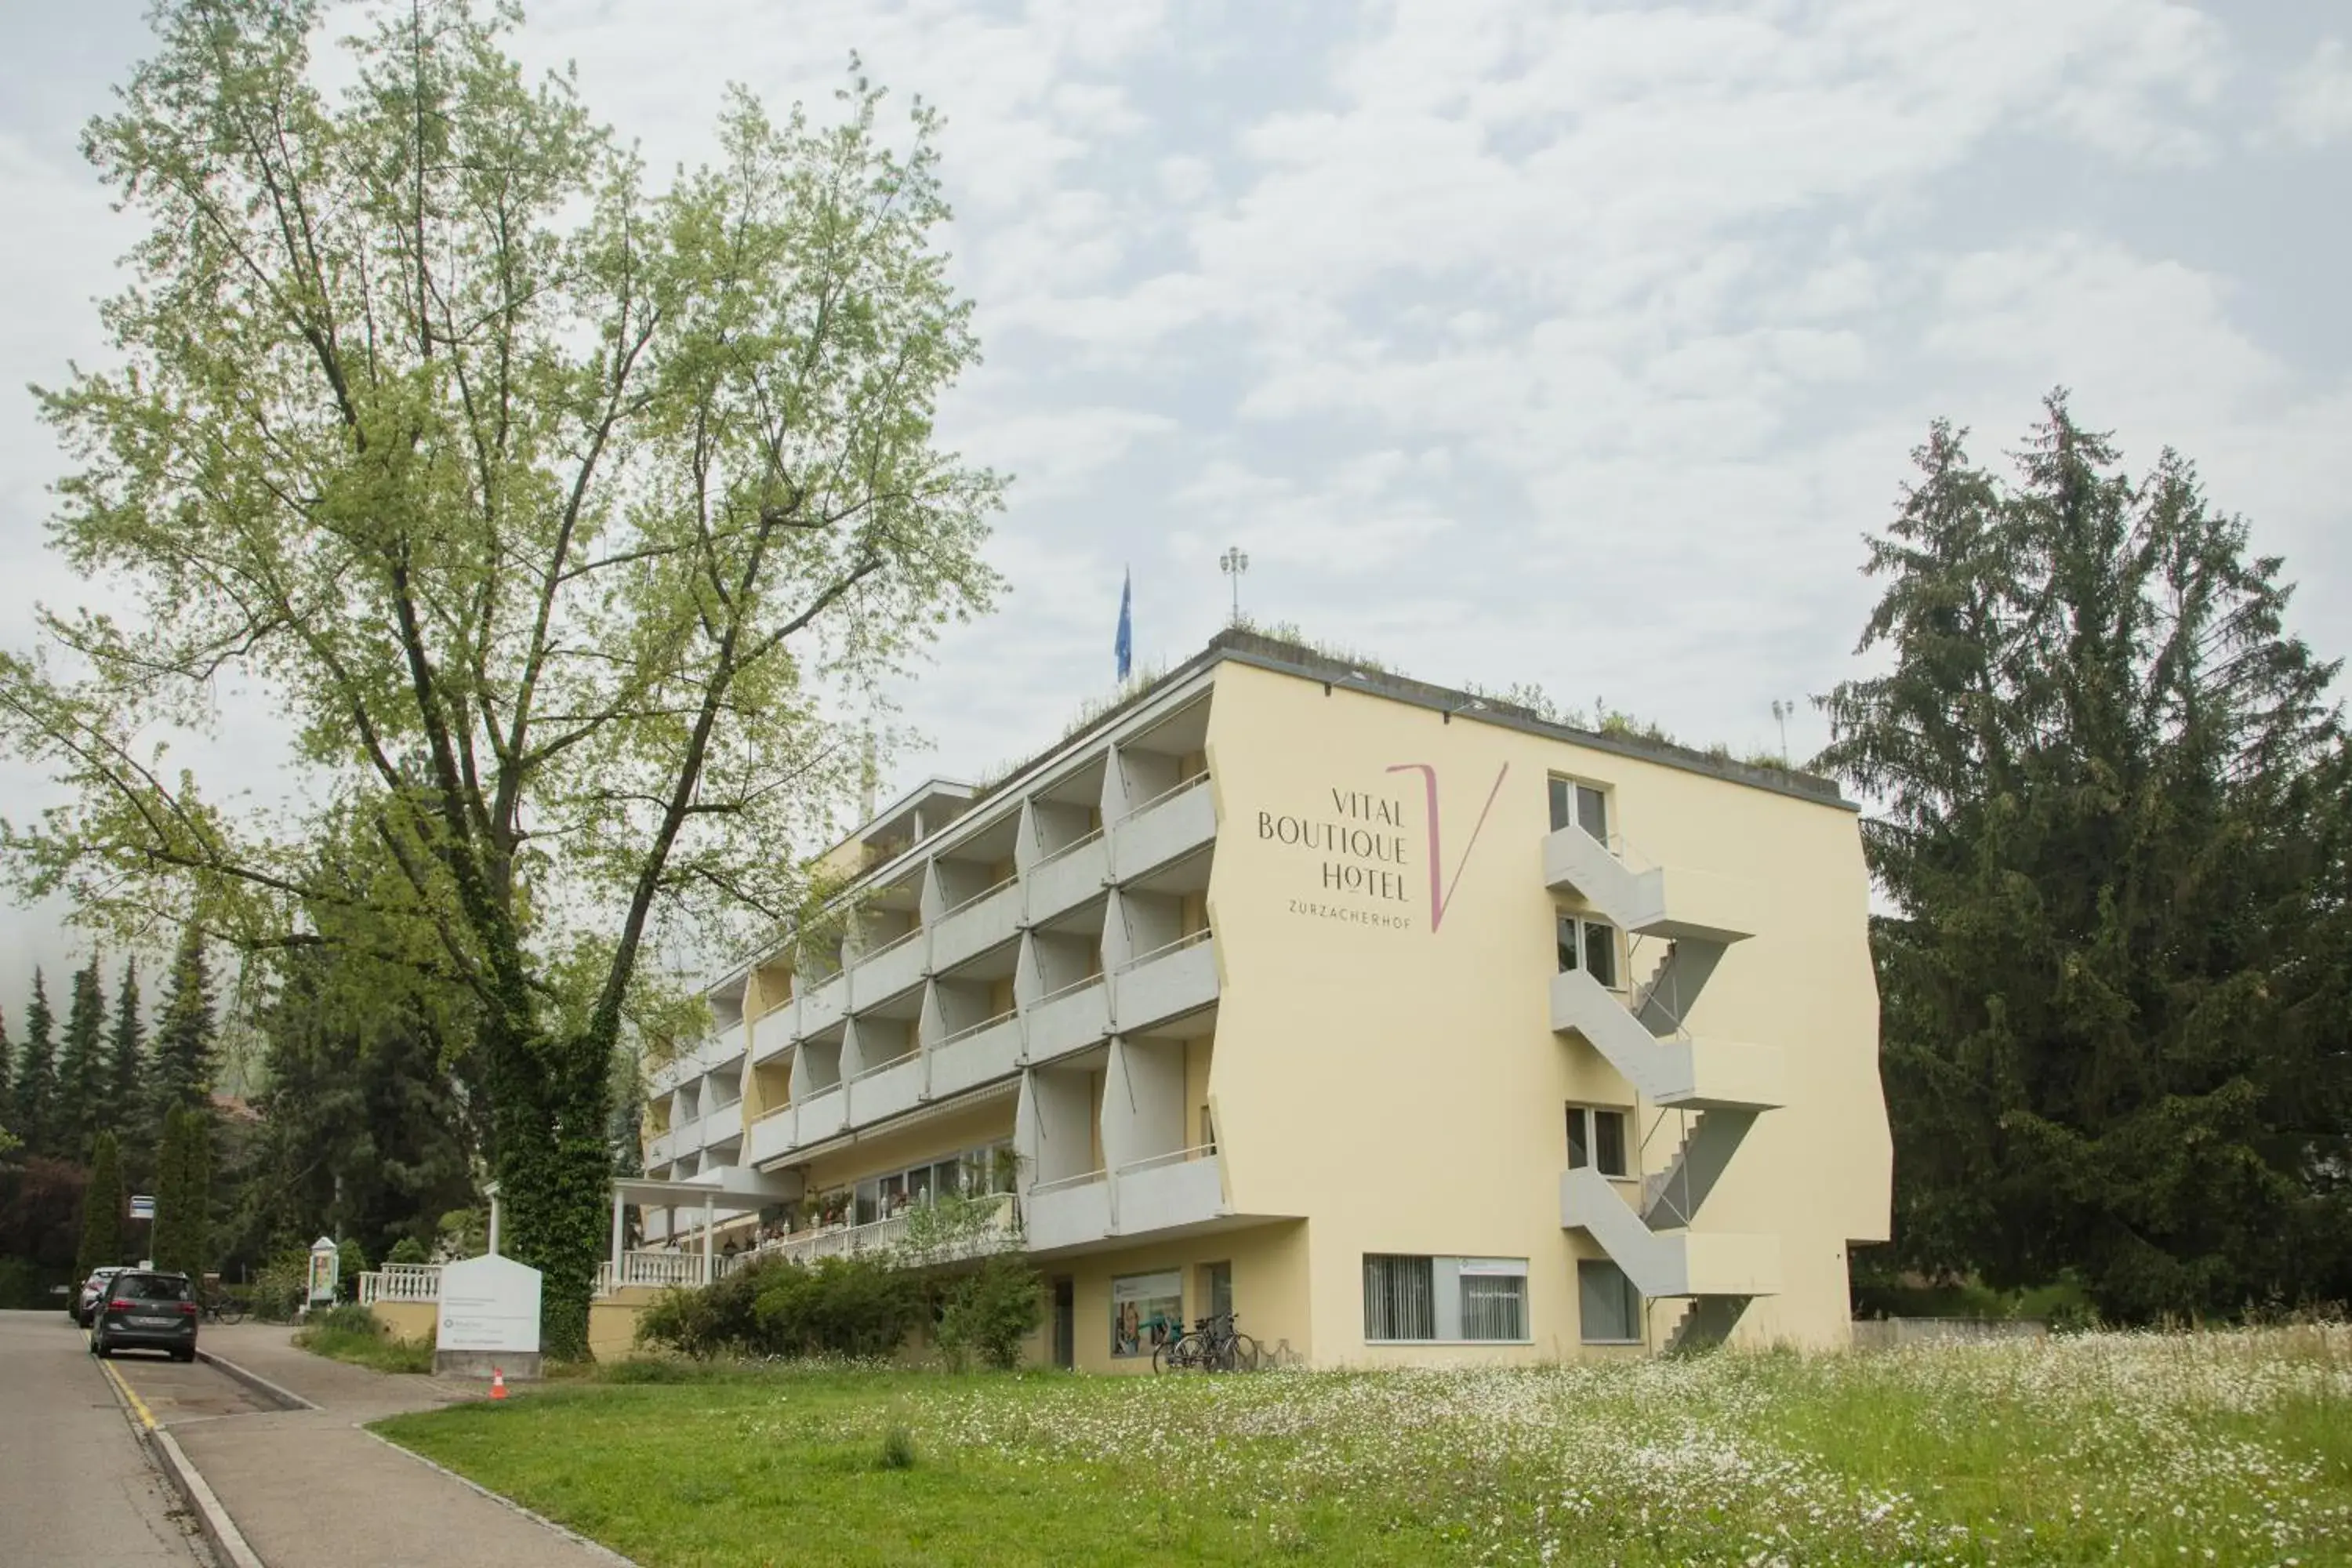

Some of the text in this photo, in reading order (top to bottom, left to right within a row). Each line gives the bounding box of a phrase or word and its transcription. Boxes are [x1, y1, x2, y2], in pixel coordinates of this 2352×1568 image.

[1332, 787, 1405, 828] VITAL
[1258, 811, 1409, 865] BOUTIQUE
[1323, 862, 1410, 902] HOTEL
[1289, 899, 1412, 929] ZURZACHERHOF
